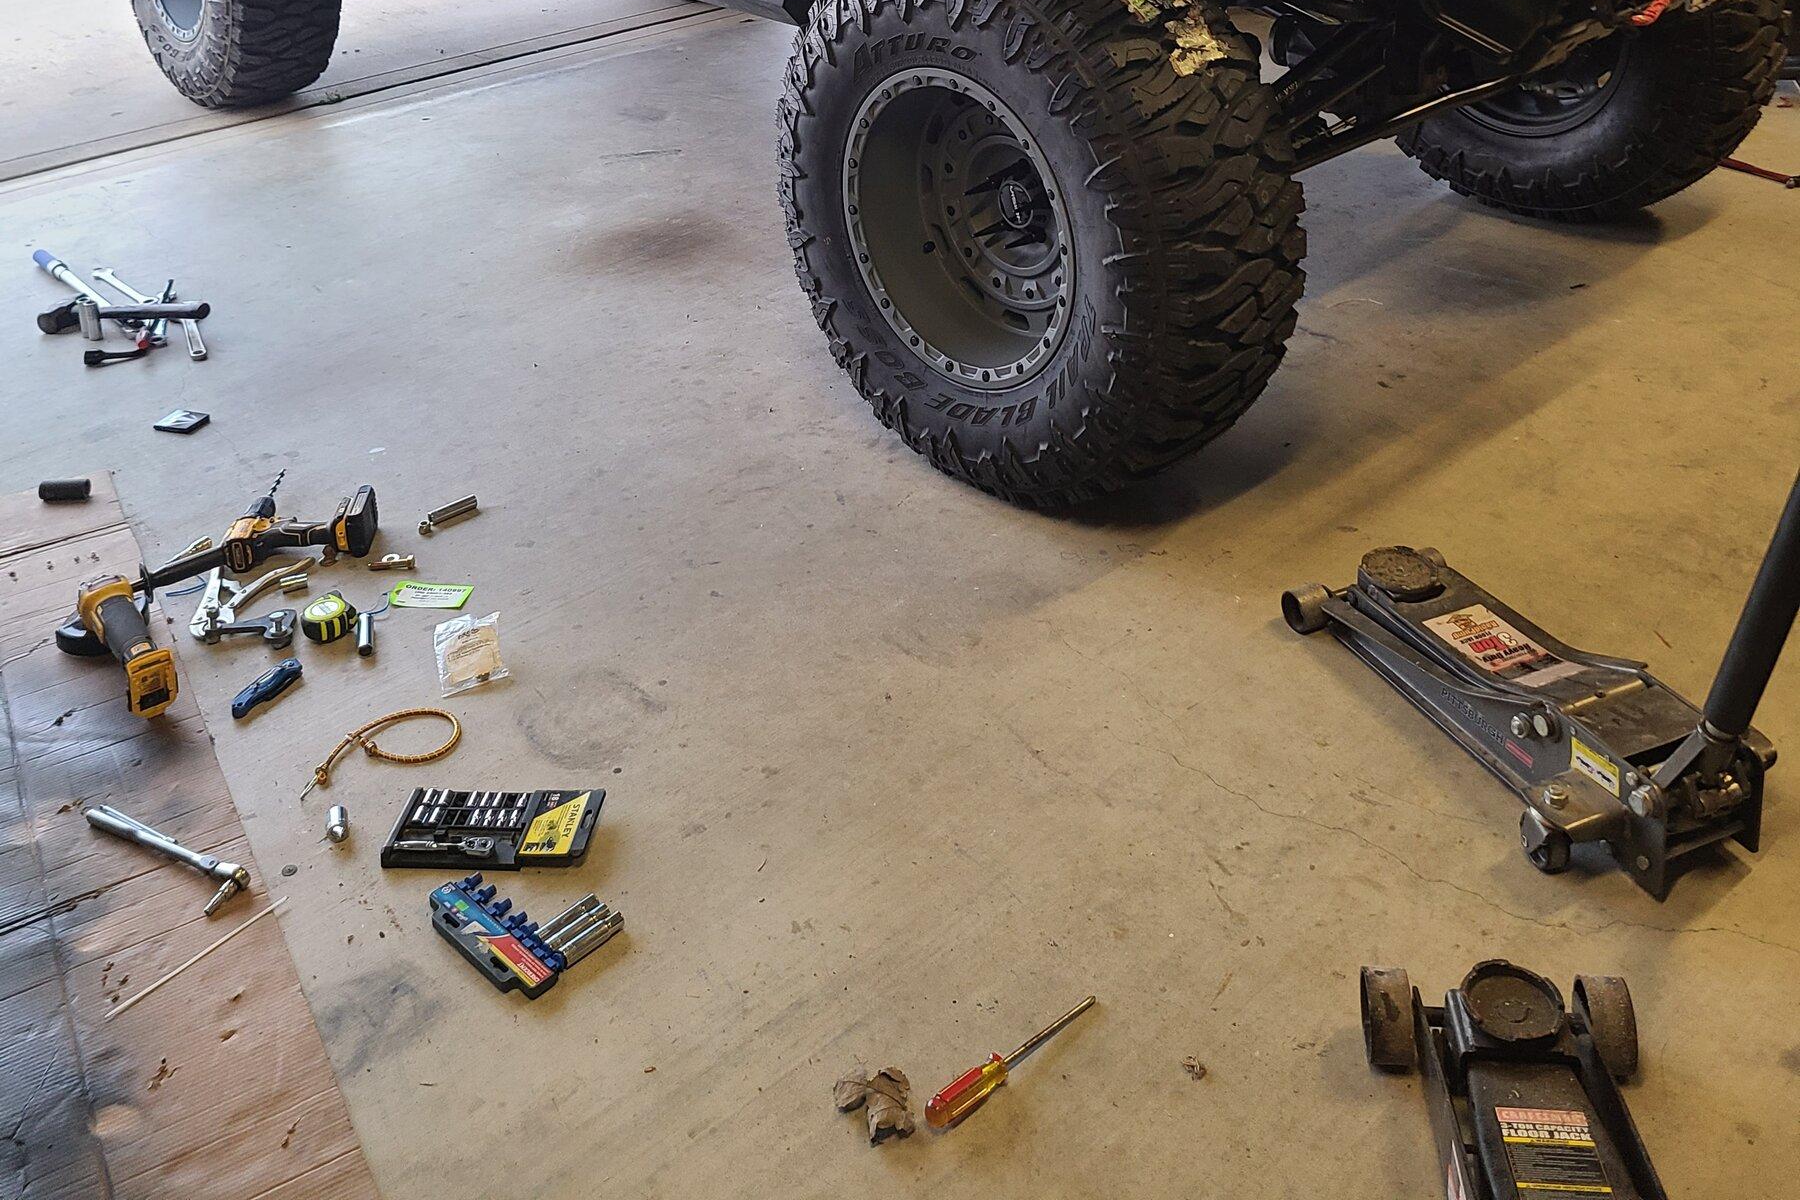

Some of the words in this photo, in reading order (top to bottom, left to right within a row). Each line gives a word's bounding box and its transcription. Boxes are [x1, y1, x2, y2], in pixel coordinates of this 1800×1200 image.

[923, 392, 1039, 427] BLADE
[1496, 632, 1518, 647] 3
[1440, 687, 1505, 746] PITTSBURGH
[561, 803, 580, 838] STANLEY
[1501, 1128, 1551, 1139] FLOOR
[1553, 1130, 1592, 1141] JACK
[1535, 1123, 1589, 1134] CAPACITY
